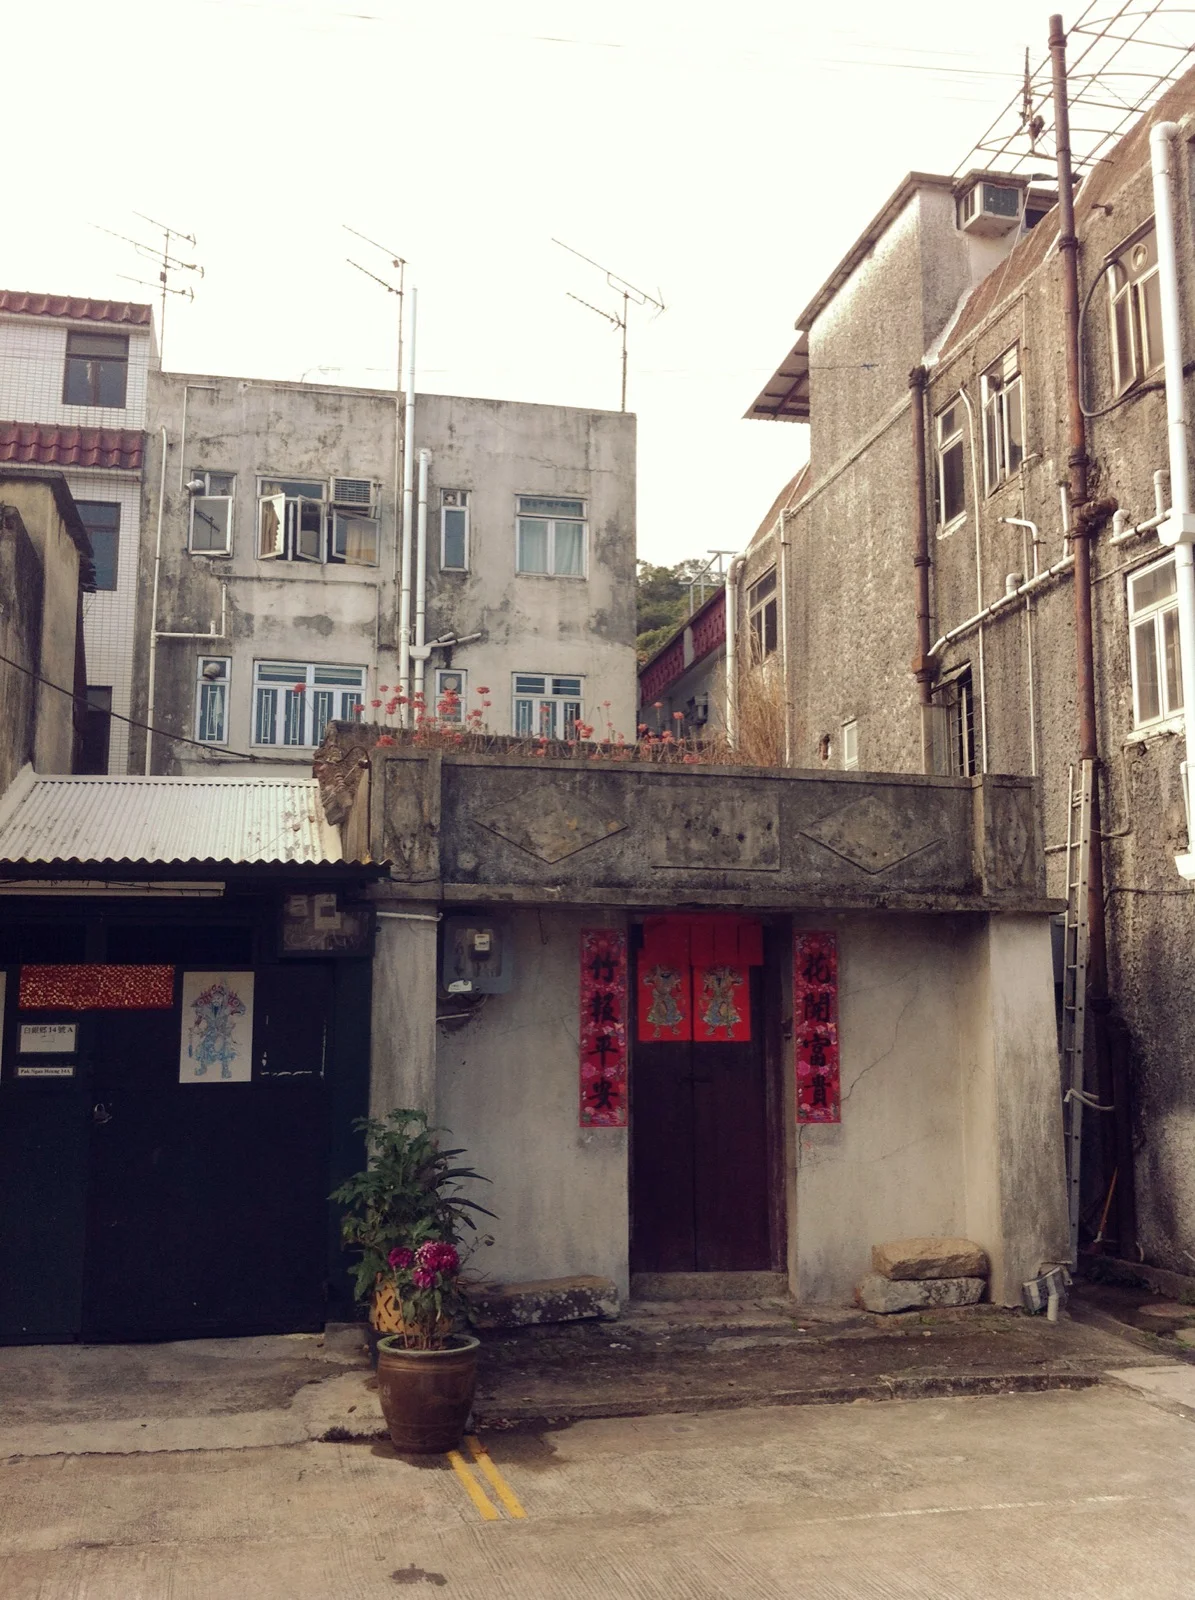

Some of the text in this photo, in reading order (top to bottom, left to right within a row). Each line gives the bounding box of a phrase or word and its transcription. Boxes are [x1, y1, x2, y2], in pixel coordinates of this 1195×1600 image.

[588, 954, 618, 1109] 竹報平安
[803, 954, 832, 1107] 花開富貴
